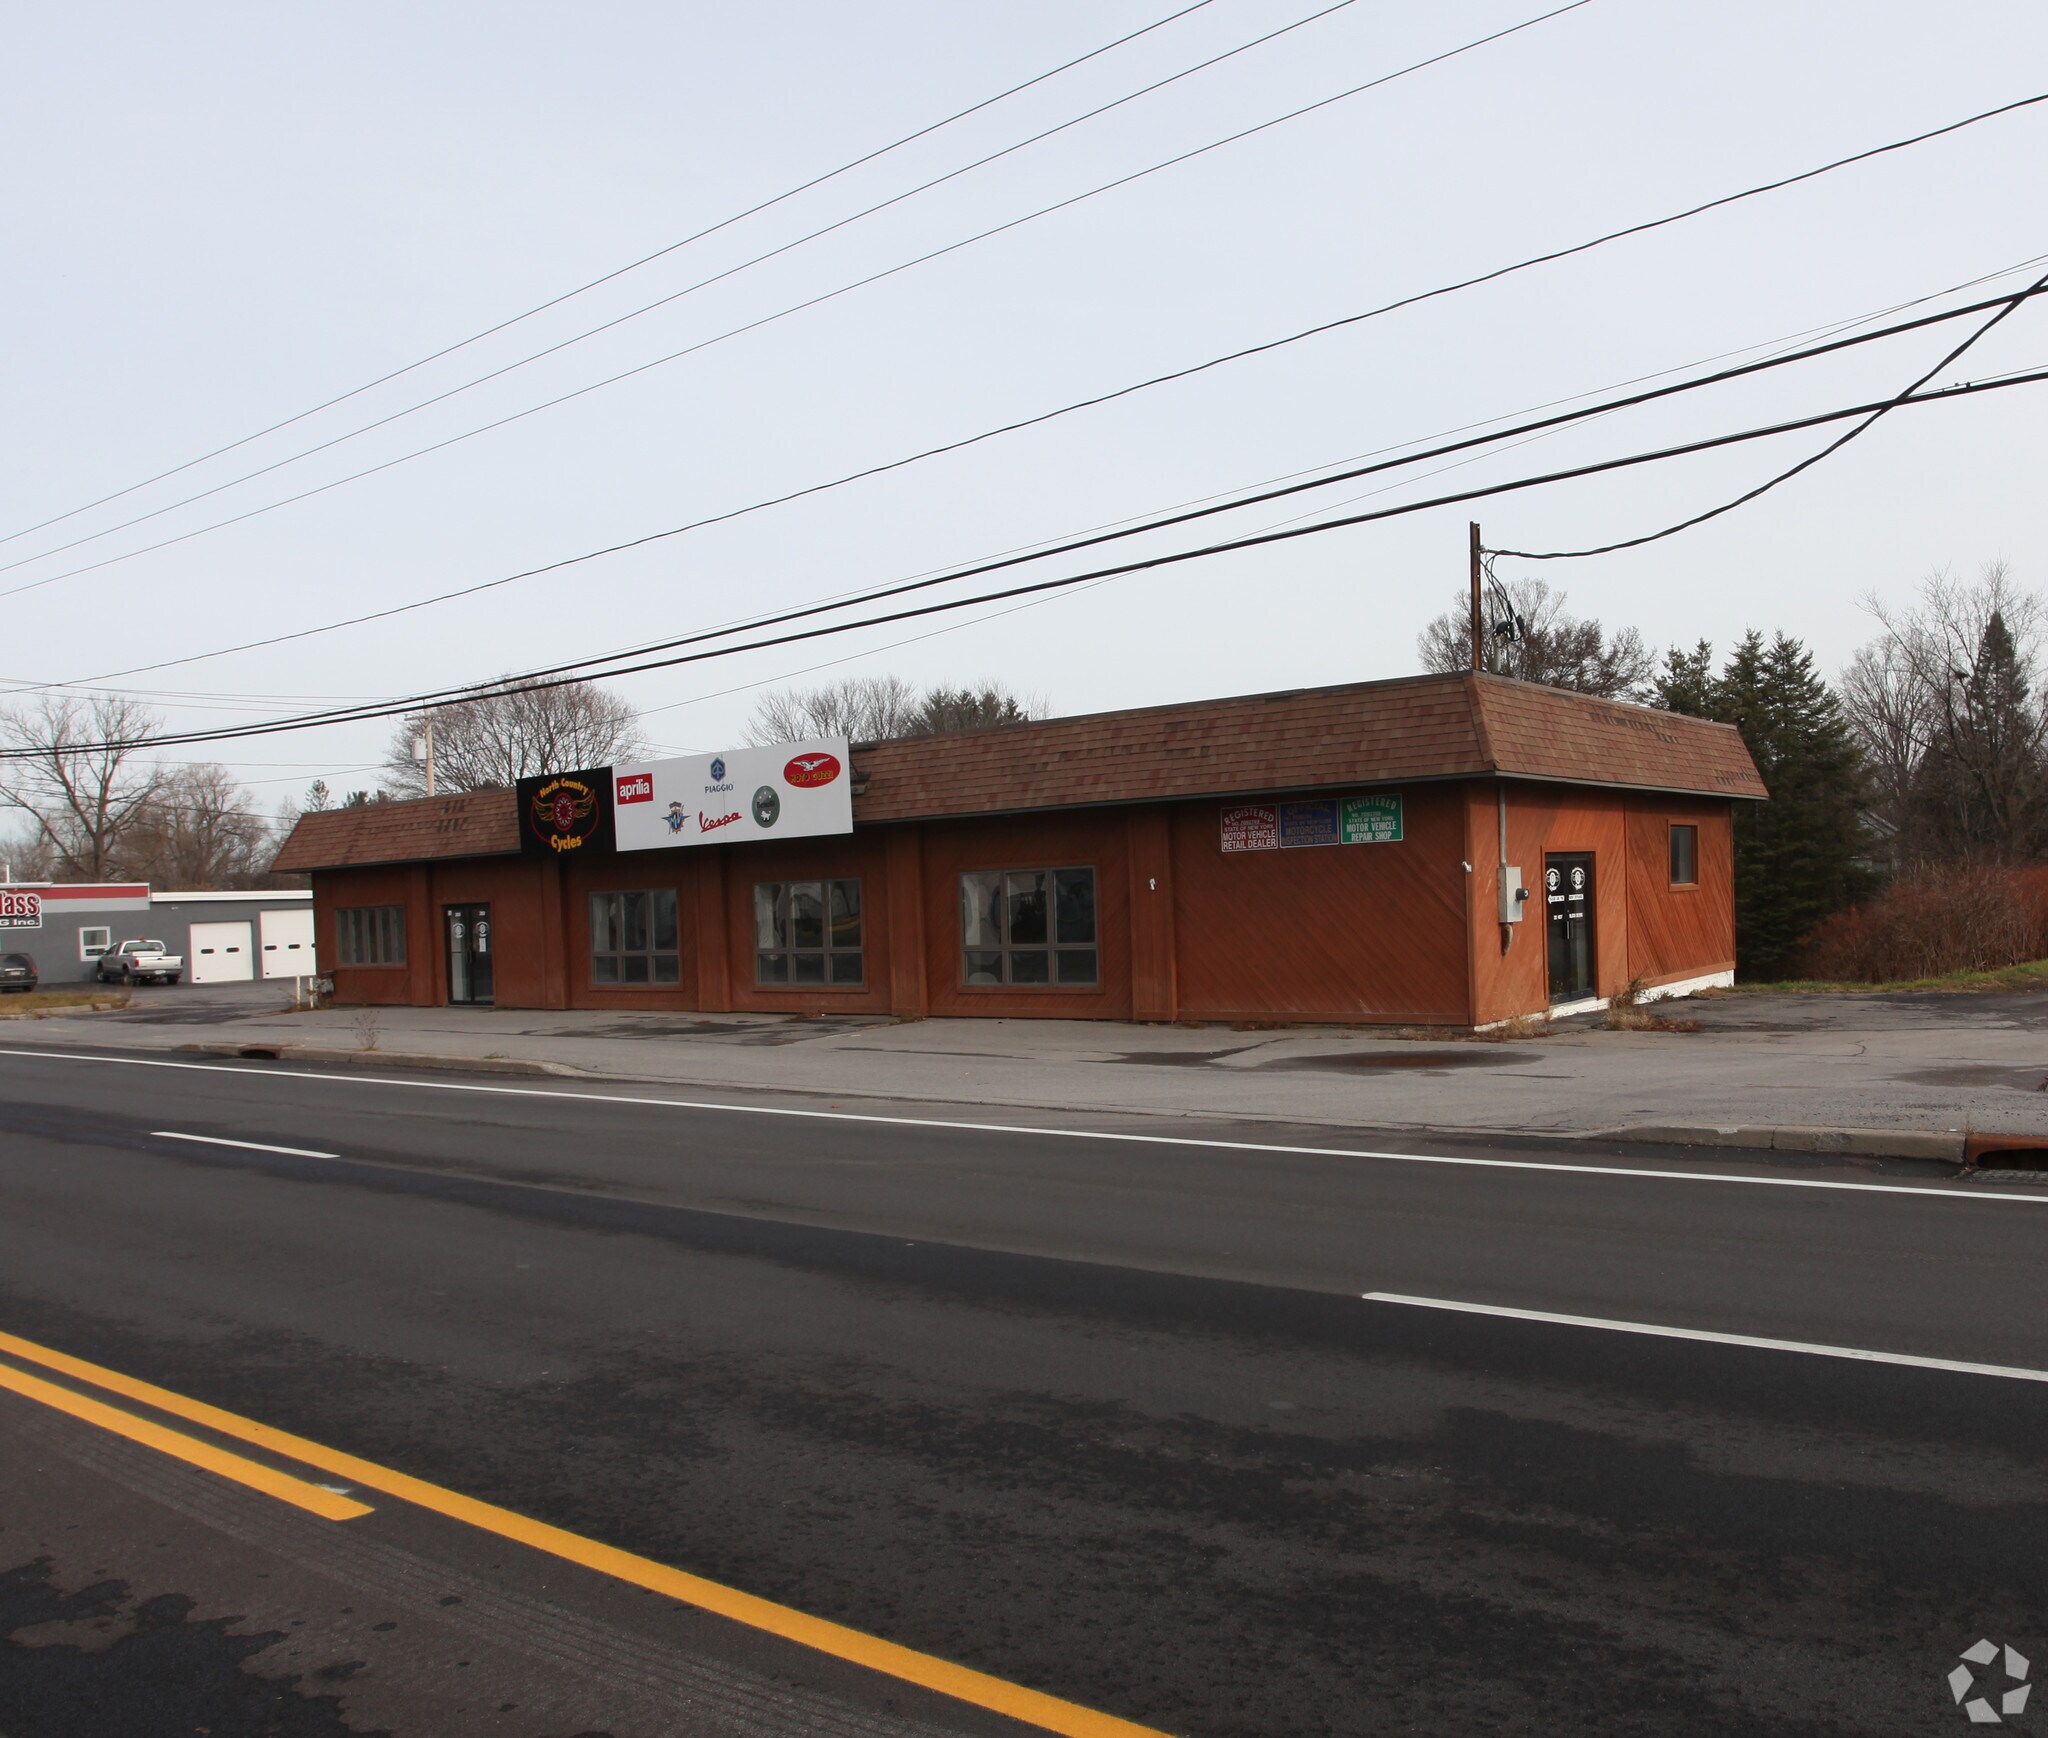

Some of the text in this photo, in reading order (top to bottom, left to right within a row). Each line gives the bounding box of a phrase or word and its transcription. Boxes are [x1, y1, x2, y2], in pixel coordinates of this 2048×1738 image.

[539, 777, 589, 798] North Country
[619, 778, 650, 800] aprilia
[704, 783, 734, 794] PIAGGIO
[1347, 797, 1397, 812] REGISTERED
[698, 810, 743, 833] Vespa
[1224, 808, 1275, 825] REGISTERED
[1285, 823, 1332, 836] MOTORCYCLE
[1346, 820, 1397, 833] MOTOR VEHICLE
[1223, 829, 1276, 841] MOTOR VEHICLE
[1281, 833, 1337, 846] INSPECTION STATION
[1351, 831, 1393, 842] REPAIR SHOP
[550, 833, 582, 853] Cycles
[1223, 838, 1277, 850] RETAIL DEALER
[13, 918, 39, 926] Inc.
